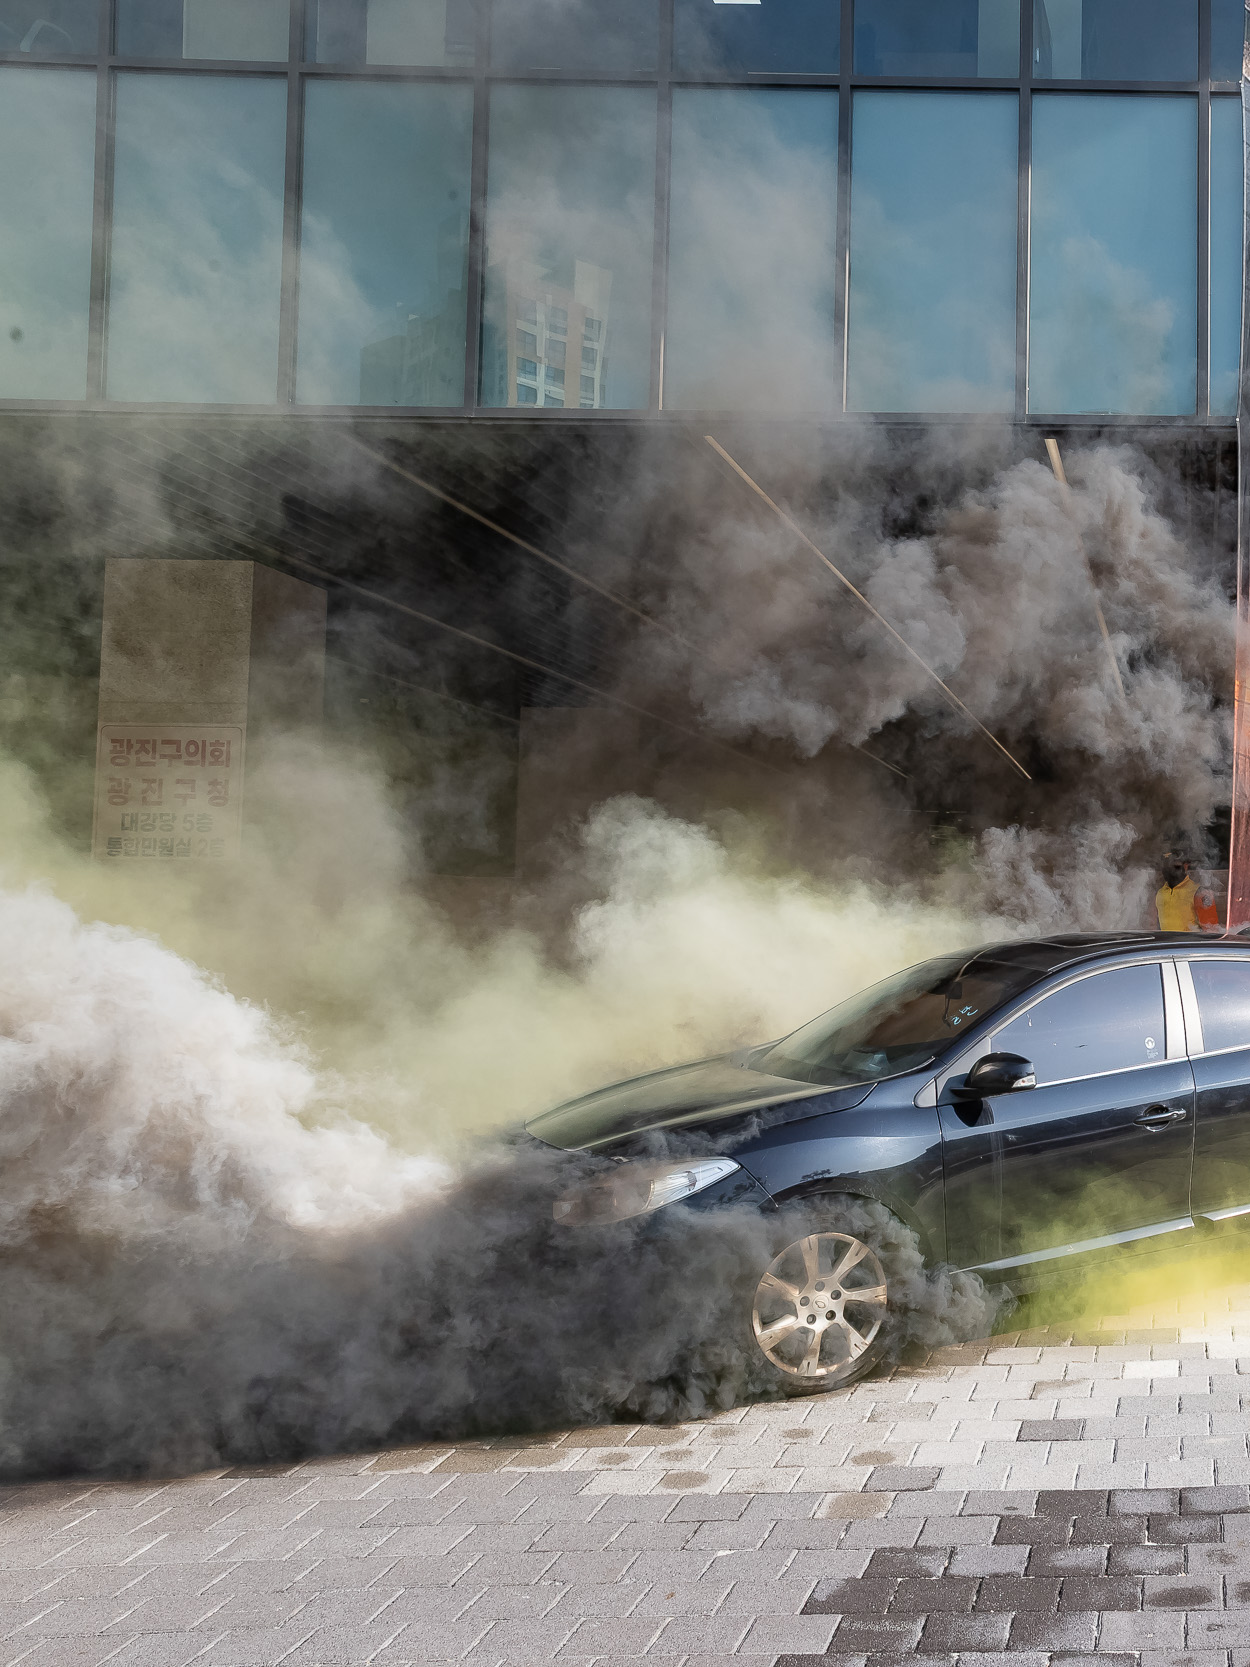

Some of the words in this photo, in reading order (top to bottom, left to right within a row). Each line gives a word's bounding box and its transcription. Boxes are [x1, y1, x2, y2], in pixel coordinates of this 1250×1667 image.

[109, 738, 232, 768] 광진구의회
[120, 812, 176, 833] 대강당
[182, 812, 214, 833] 5층
[106, 836, 192, 857] 통합민원실
